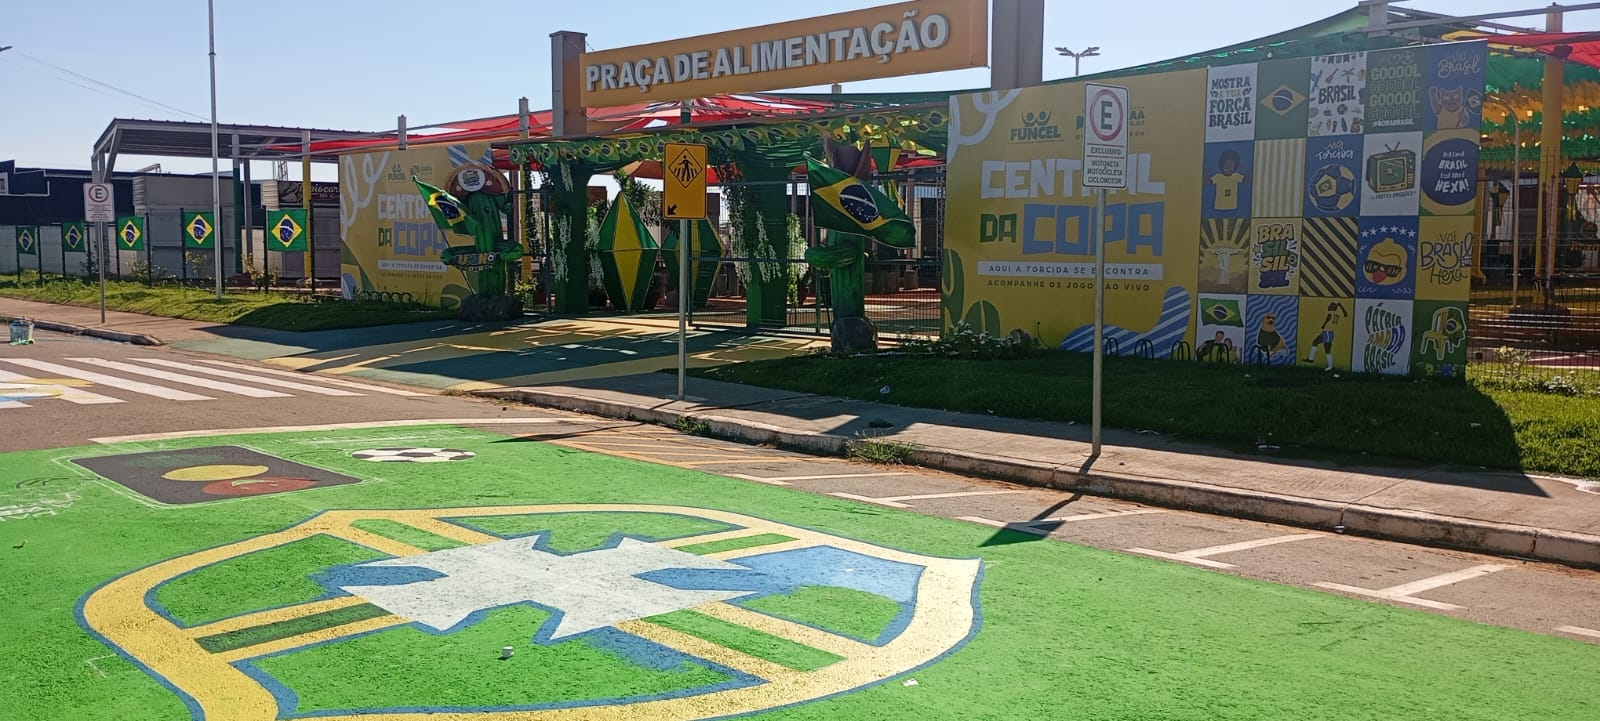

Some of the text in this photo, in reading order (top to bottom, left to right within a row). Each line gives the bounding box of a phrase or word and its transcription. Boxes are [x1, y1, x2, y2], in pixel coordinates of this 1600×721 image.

[586, 9, 950, 93] PRAÇA DE ALIMENTAÇÃO
[1371, 64, 1421, 80] GOOOOL
[1211, 76, 1251, 90] MOSTRA
[1209, 97, 1251, 113] FORÇA
[1101, 101, 1112, 130] E
[1010, 126, 1061, 141] FUNCEL
[1090, 147, 1121, 155] EXCLUSIVO
[981, 153, 1166, 199] CENTL
[1087, 168, 1122, 176] MOTOCICLETA
[95, 187, 103, 199] E
[1434, 178, 1470, 193] HEXA!
[378, 193, 432, 219] CENTR
[378, 227, 392, 247] DA
[980, 201, 1164, 256] DA COPA
[1257, 224, 1295, 244] BRA
[1262, 240, 1289, 257] SIL
[989, 265, 1149, 276] AQUI A TORCIDA SE ECONTRA
[1259, 256, 1290, 273] SIL
[987, 280, 1045, 288] ACOMPANHE
[1066, 282, 1098, 290] JOGO
[1124, 283, 1150, 292] VIVO
[1365, 302, 1402, 334] PÁTRIA
[1364, 344, 1396, 373] BRASIL
